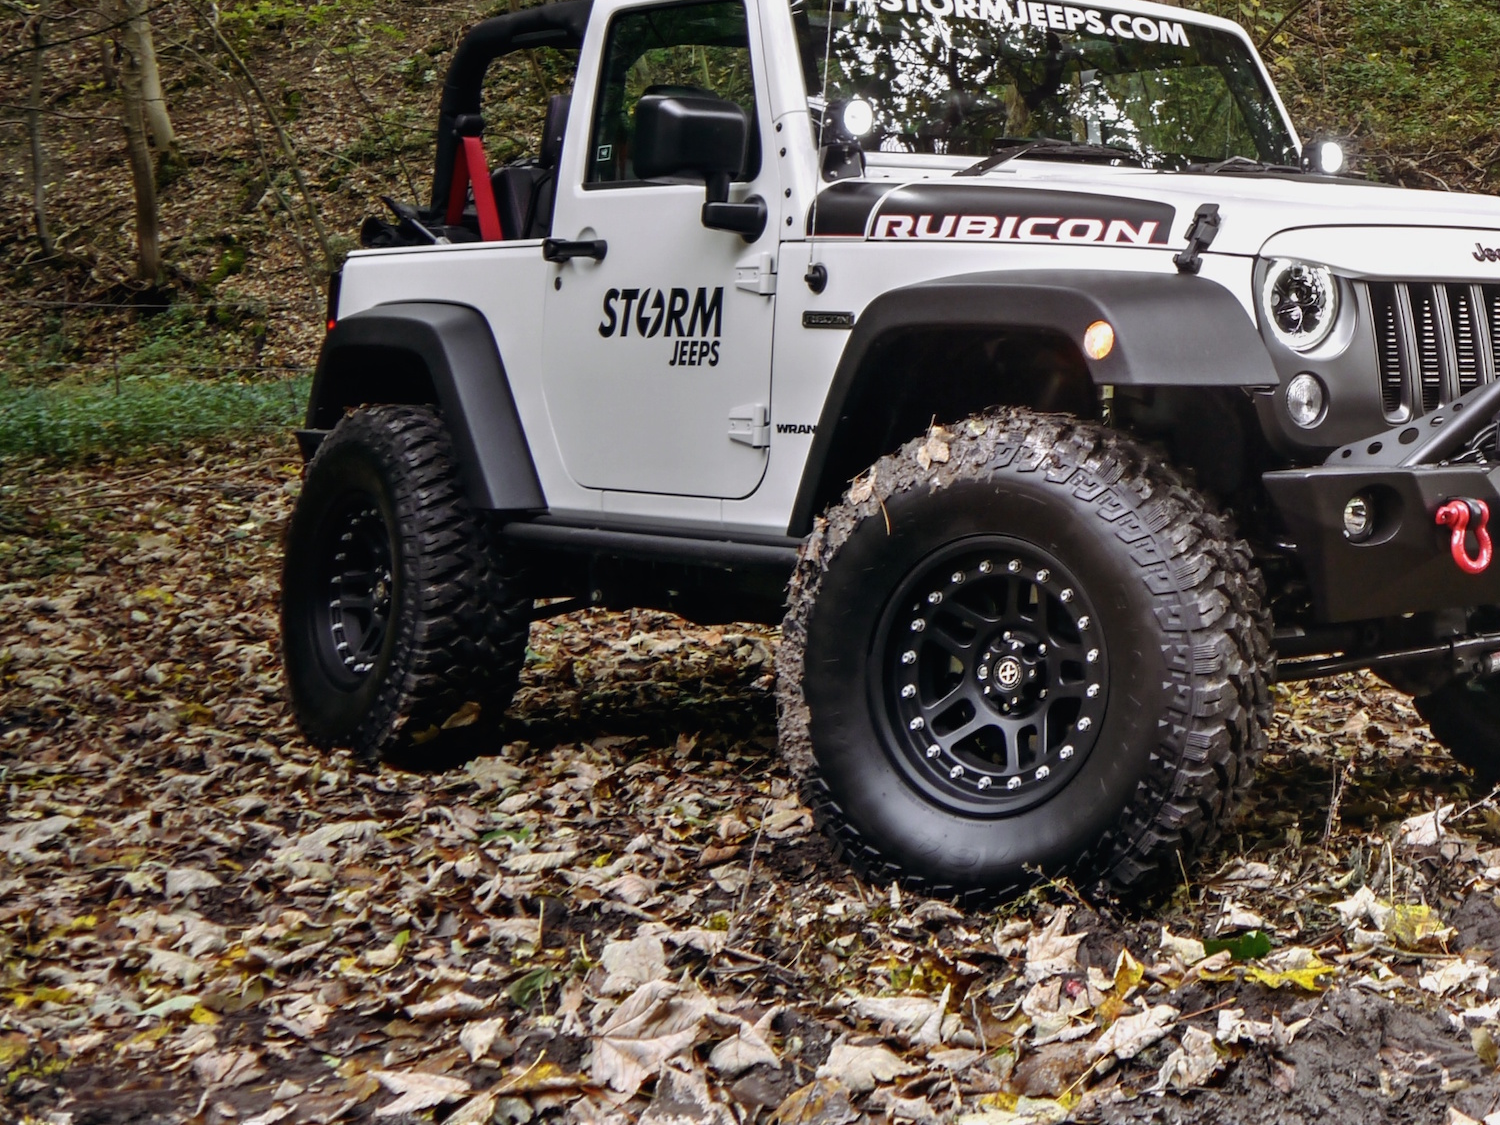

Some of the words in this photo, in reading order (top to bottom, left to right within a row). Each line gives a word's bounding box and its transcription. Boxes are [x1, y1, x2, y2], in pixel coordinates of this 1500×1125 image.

[874, 214, 1160, 244] RUBICON
[598, 287, 724, 338] STORM
[669, 340, 720, 367] JEEPS
